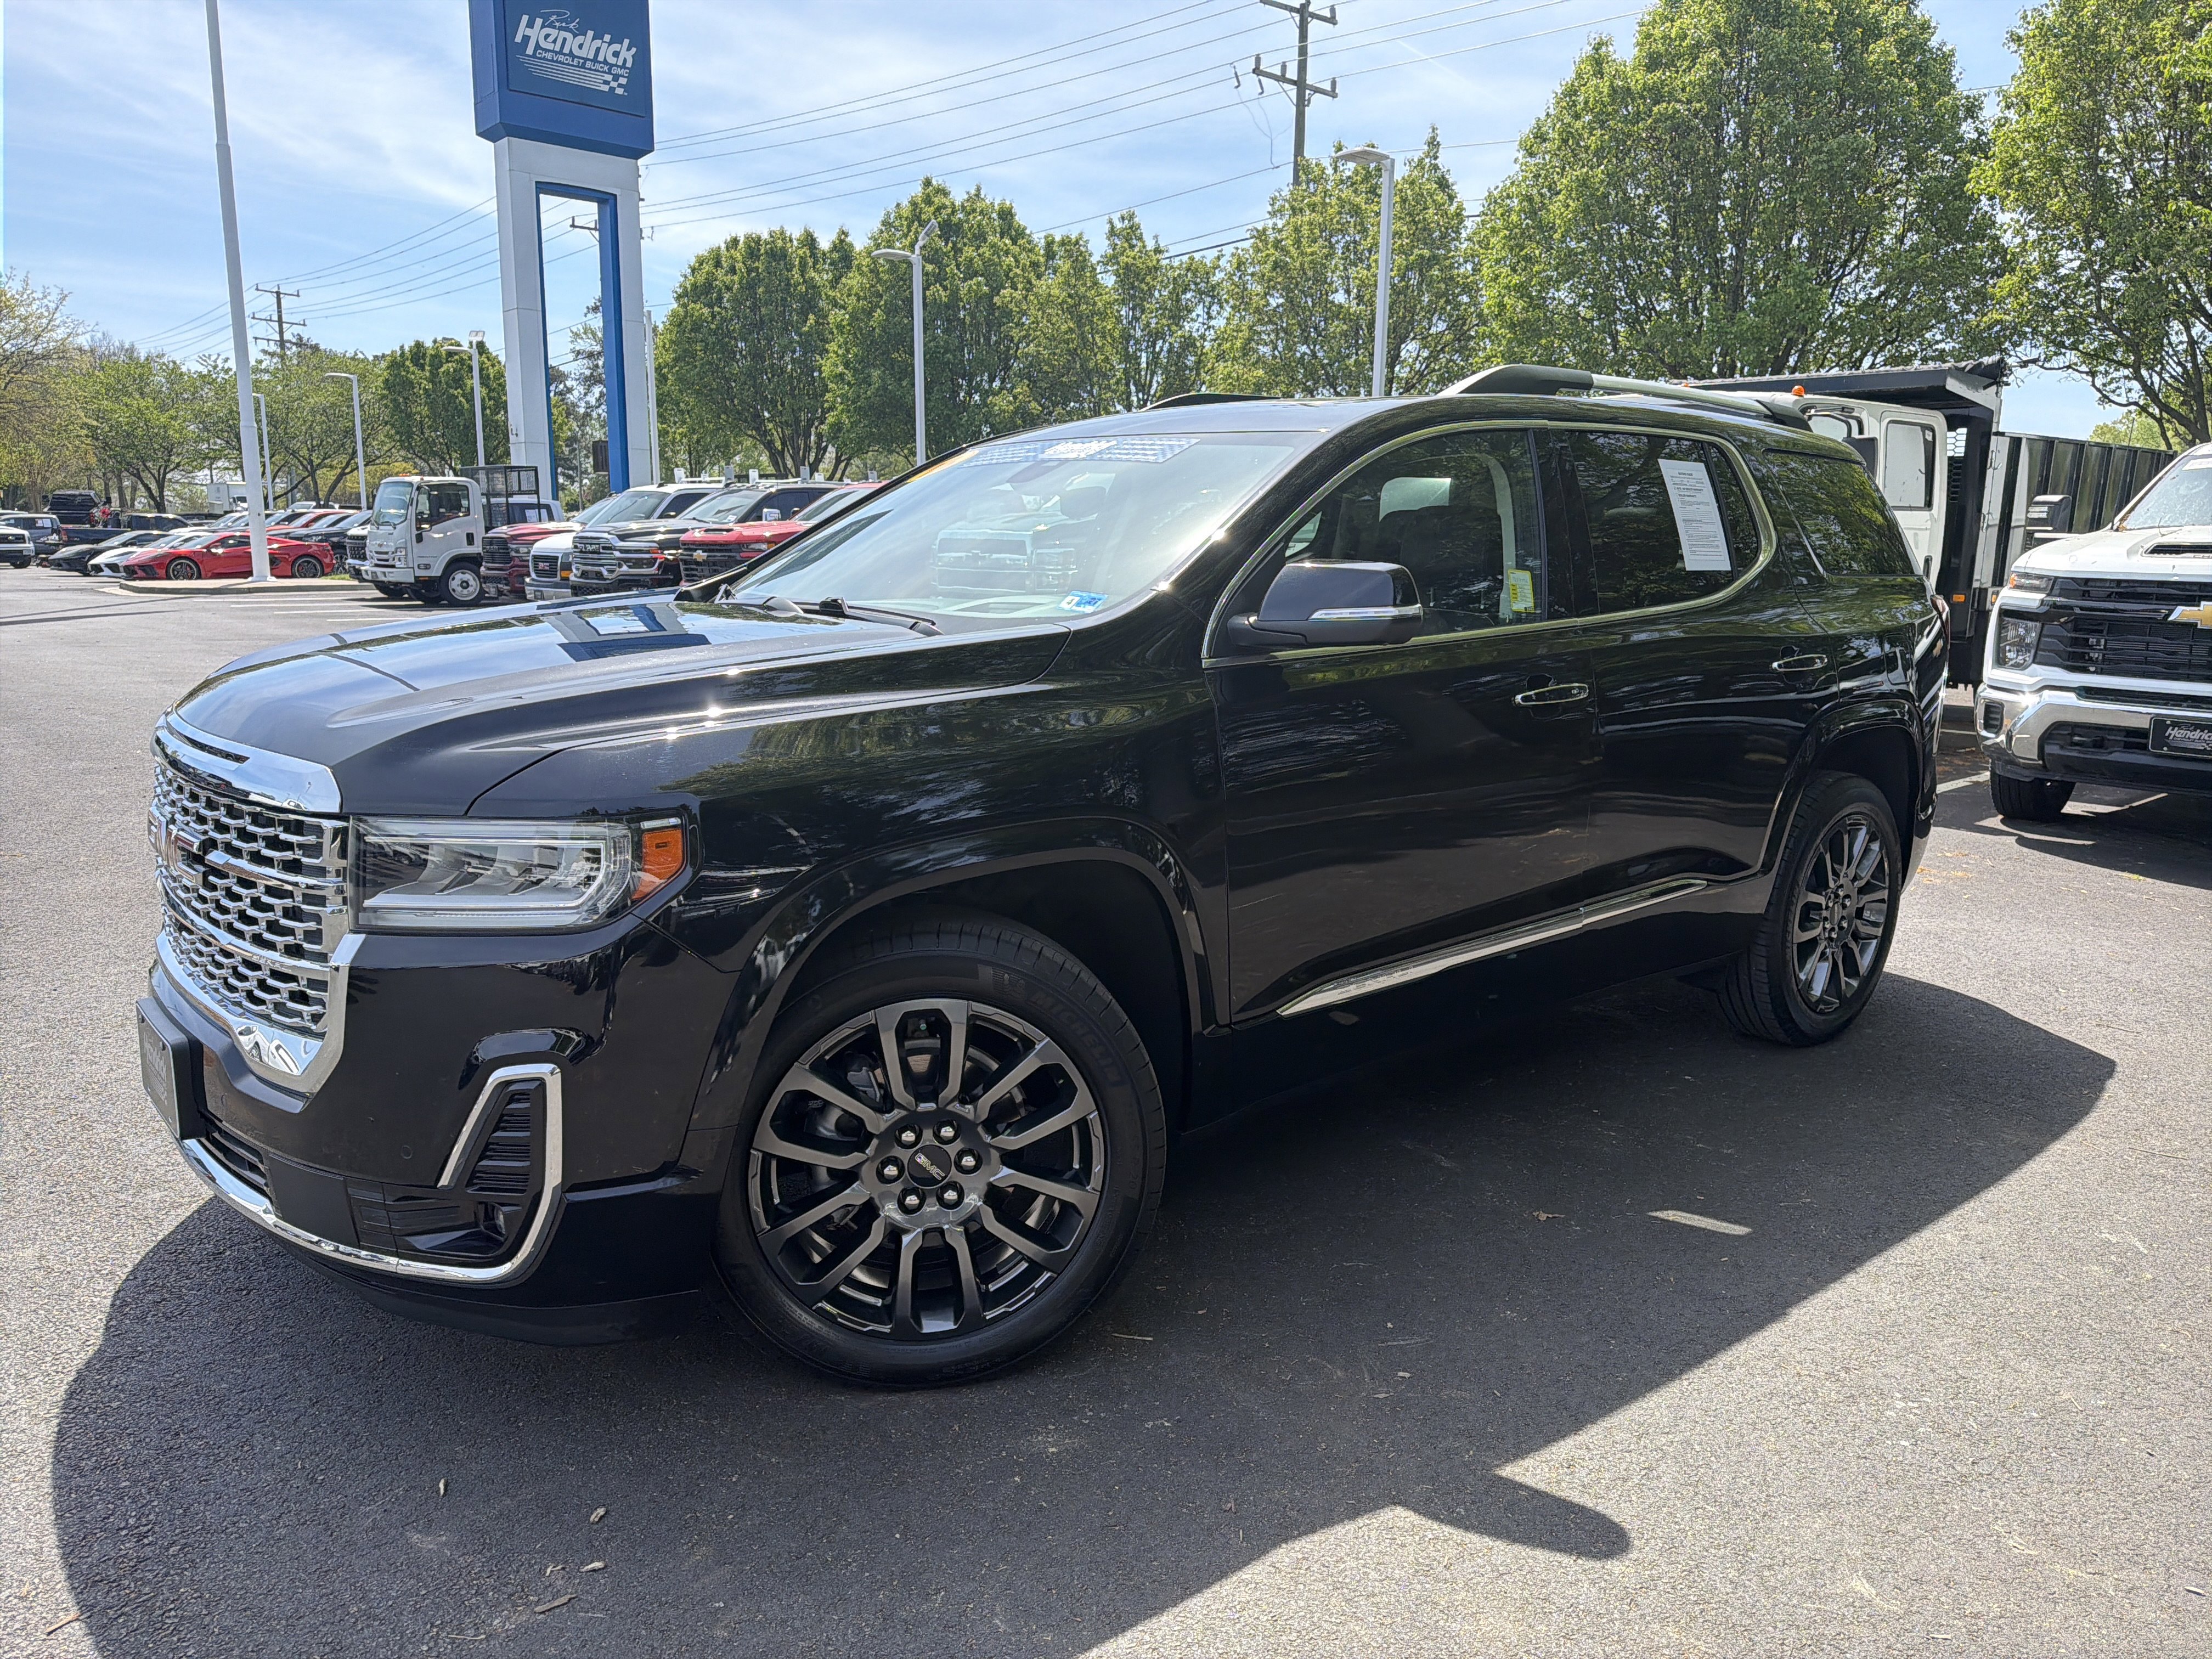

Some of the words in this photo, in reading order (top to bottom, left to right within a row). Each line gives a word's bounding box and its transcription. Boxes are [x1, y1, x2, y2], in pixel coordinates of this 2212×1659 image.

[540, 9, 580, 33] Rick
[514, 14, 637, 67] Hendrick
[536, 49, 584, 66] CHEVROLET
[585, 61, 609, 72] BUICK
[611, 66, 629, 77] GMC
[2164, 726, 2212, 741] Hendric
[915, 1153, 945, 1181] GMC
